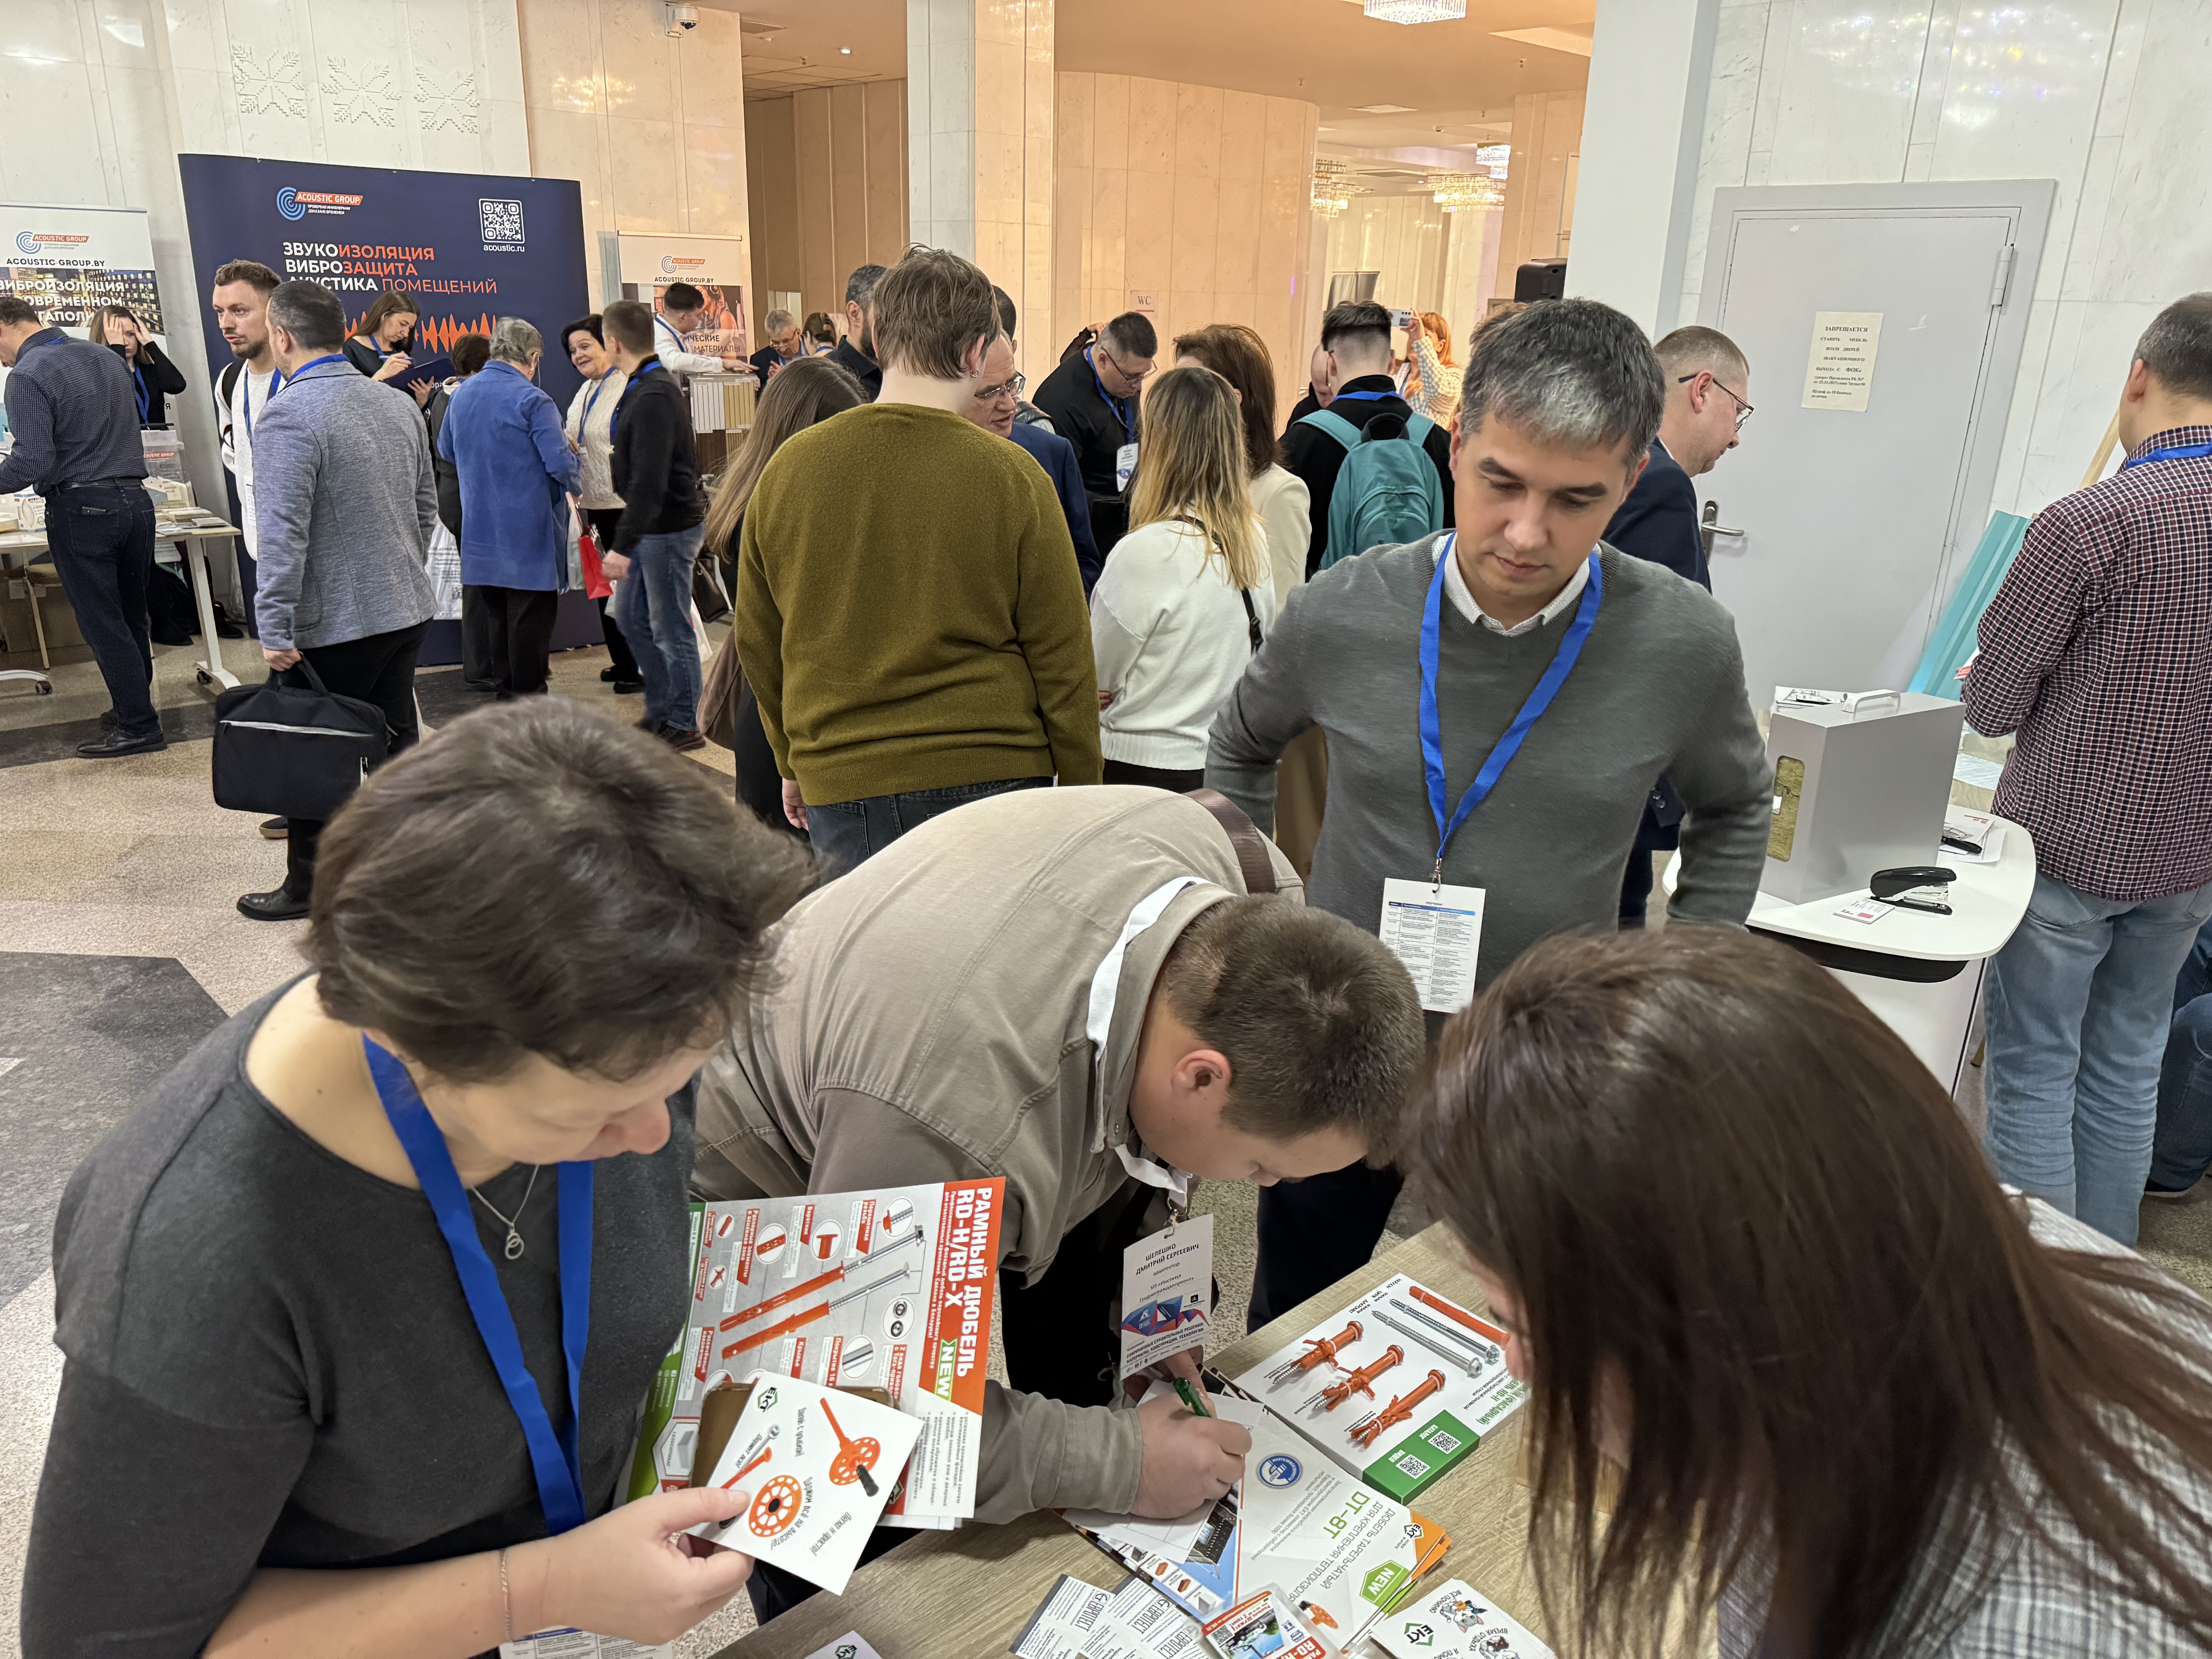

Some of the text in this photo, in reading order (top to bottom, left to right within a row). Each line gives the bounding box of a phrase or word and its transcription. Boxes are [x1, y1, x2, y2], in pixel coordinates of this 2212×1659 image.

[297, 193, 361, 204] ACOUSTIC GROUP
[283, 242, 434, 261] ЗВУКОИЗОЛЯЦИЯ
[483, 244, 525, 252] acoustic.ru
[6, 258, 105, 267] ACOUSTIC-GROUP.BY
[286, 259, 418, 277] ВИБРОЗАЩИТА
[383, 278, 497, 294] ПОМЕЩЕНИЙ
[1137, 296, 1151, 305] WC
[38, 311, 94, 322] ГАПОЛИ
[803, 1206, 813, 1235] Воротник
[860, 1201, 869, 1224] резьба
[863, 1201, 876, 1241] Переменная
[939, 1202, 948, 1243] ответственных
[742, 1215, 752, 1245] основная
[742, 1210, 759, 1278] Распорные элементы
[1136, 1244, 1199, 1276] ДМИТРИЙ СЕРГЕЕВИЧ
[929, 1191, 957, 1369] Профессиональный фасадный дюбель европейского качества
[932, 1278, 940, 1302] Сделано
[936, 1189, 975, 1396] RD-H/RD-X NEW
[954, 1187, 997, 1378] РАМНЫЙ ДЮБЕЛЬ
[927, 1309, 936, 1338] Беларуси!
[1179, 1328, 1204, 1340] ТЕХНОЛОГИИ
[697, 1330, 707, 1367] наконечник
[794, 1341, 804, 1367] Крылья
[1127, 1340, 1154, 1358] СОВРЕМЕННЫЕ
[1154, 1329, 1184, 1345] СТРОИТЕЛЬНЫЕ
[829, 1338, 841, 1382] Покрытие 16
[758, 1386, 777, 1413] EKT
[1472, 1387, 1484, 1396] стали
[1490, 1388, 1508, 1401] RD-H
[798, 1407, 806, 1423] Делай
[1476, 1395, 1516, 1425] (ФАСАДНЫЙ)
[1420, 1424, 1439, 1441] КАТАЛОГ
[666, 1432, 676, 1467] ГАЗОСИЛИКАТ
[1388, 1449, 1406, 1463] ВИДЕО
[1304, 1470, 1325, 1491] испытаний.
[1306, 1479, 1332, 1507] конструкторов
[769, 1477, 813, 1550] Держим всё на высоте!
[1270, 1479, 1341, 1552] Запатентованная разработка инженеров
[1291, 1491, 1314, 1514] прошедшая
[1298, 1506, 1309, 1515] EKT
[1322, 1490, 1370, 1539] DT-8T
[834, 1511, 852, 1530] Легко
[1271, 1523, 1282, 1534] 1000
[1279, 1514, 1300, 1534] совместно
[1280, 1513, 1293, 1525] более
[1406, 1523, 1420, 1539] EKT
[809, 1530, 833, 1556] просто!
[1250, 1535, 1278, 1561] лабораторией
[1287, 1500, 1383, 1602] ДЛЯ КРЕПЛЕНИЯ ТЕПЛОИЗОЛЯ
[1320, 1508, 1395, 1590] ДЮБЕЛЬ ТАРЕЛЬЧАТЫЙ
[1367, 1567, 1395, 1595] NEW
[1074, 1600, 1104, 1632] ЕВРОТЕСТ
[1429, 1594, 1451, 1614] ПОЧИНЮ
[1131, 1604, 1164, 1635] ЕВРОТЕСТ
[1157, 1631, 1193, 1659] ЕВРОТЕСТ
[1406, 1623, 1433, 1643] EKT
[1467, 1631, 1486, 1652] ОТДЫХА
[1452, 1647, 1460, 1655] Я
